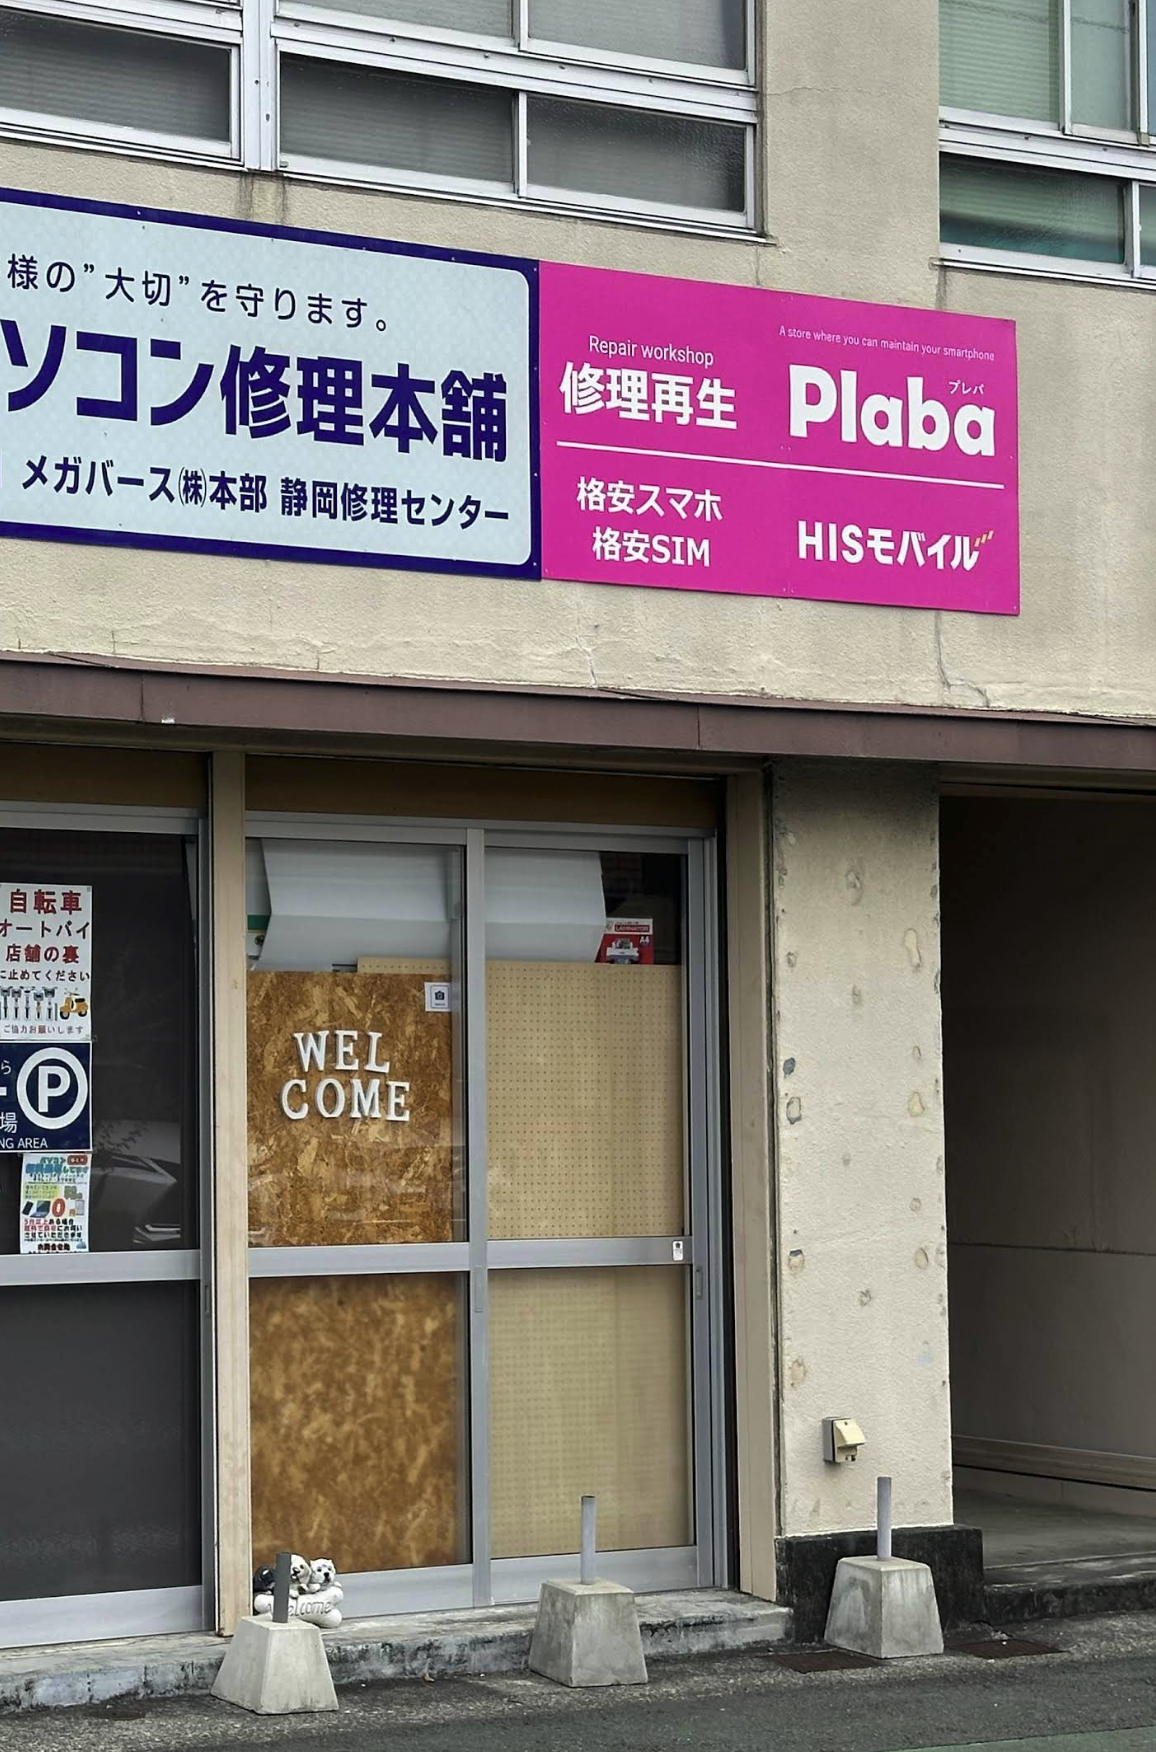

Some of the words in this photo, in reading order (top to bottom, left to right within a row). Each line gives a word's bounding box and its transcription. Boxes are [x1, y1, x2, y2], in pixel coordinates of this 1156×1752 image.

[589, 335, 637, 358] Repair
[641, 343, 714, 368] workshop
[779, 325, 786, 336] A
[788, 328, 811, 340] store
[813, 330, 841, 343] where
[843, 335, 859, 346] you
[862, 337, 878, 347] can
[881, 339, 919, 352] maintain
[921, 343, 940, 355] your
[943, 346, 995, 361] smartphone
[559, 361, 737, 430] 修理再生
[789, 364, 995, 457] Plaba
[281, 477, 509, 529] 静岡修理センター
[577, 476, 723, 522] 格安スマホ
[593, 526, 710, 567] 格安SIM
[798, 520, 984, 571] HISモバイル
[10, 889, 82, 915] 自転車
[6, 943, 80, 964] 店舗の裏
[3, 1025, 83, 1035] ご協力お願いします
[293, 1030, 390, 1073] WEL
[38, 1065, 71, 1113] P
[281, 1078, 410, 1121] COME
[18, 1138, 48, 1149] AREA
